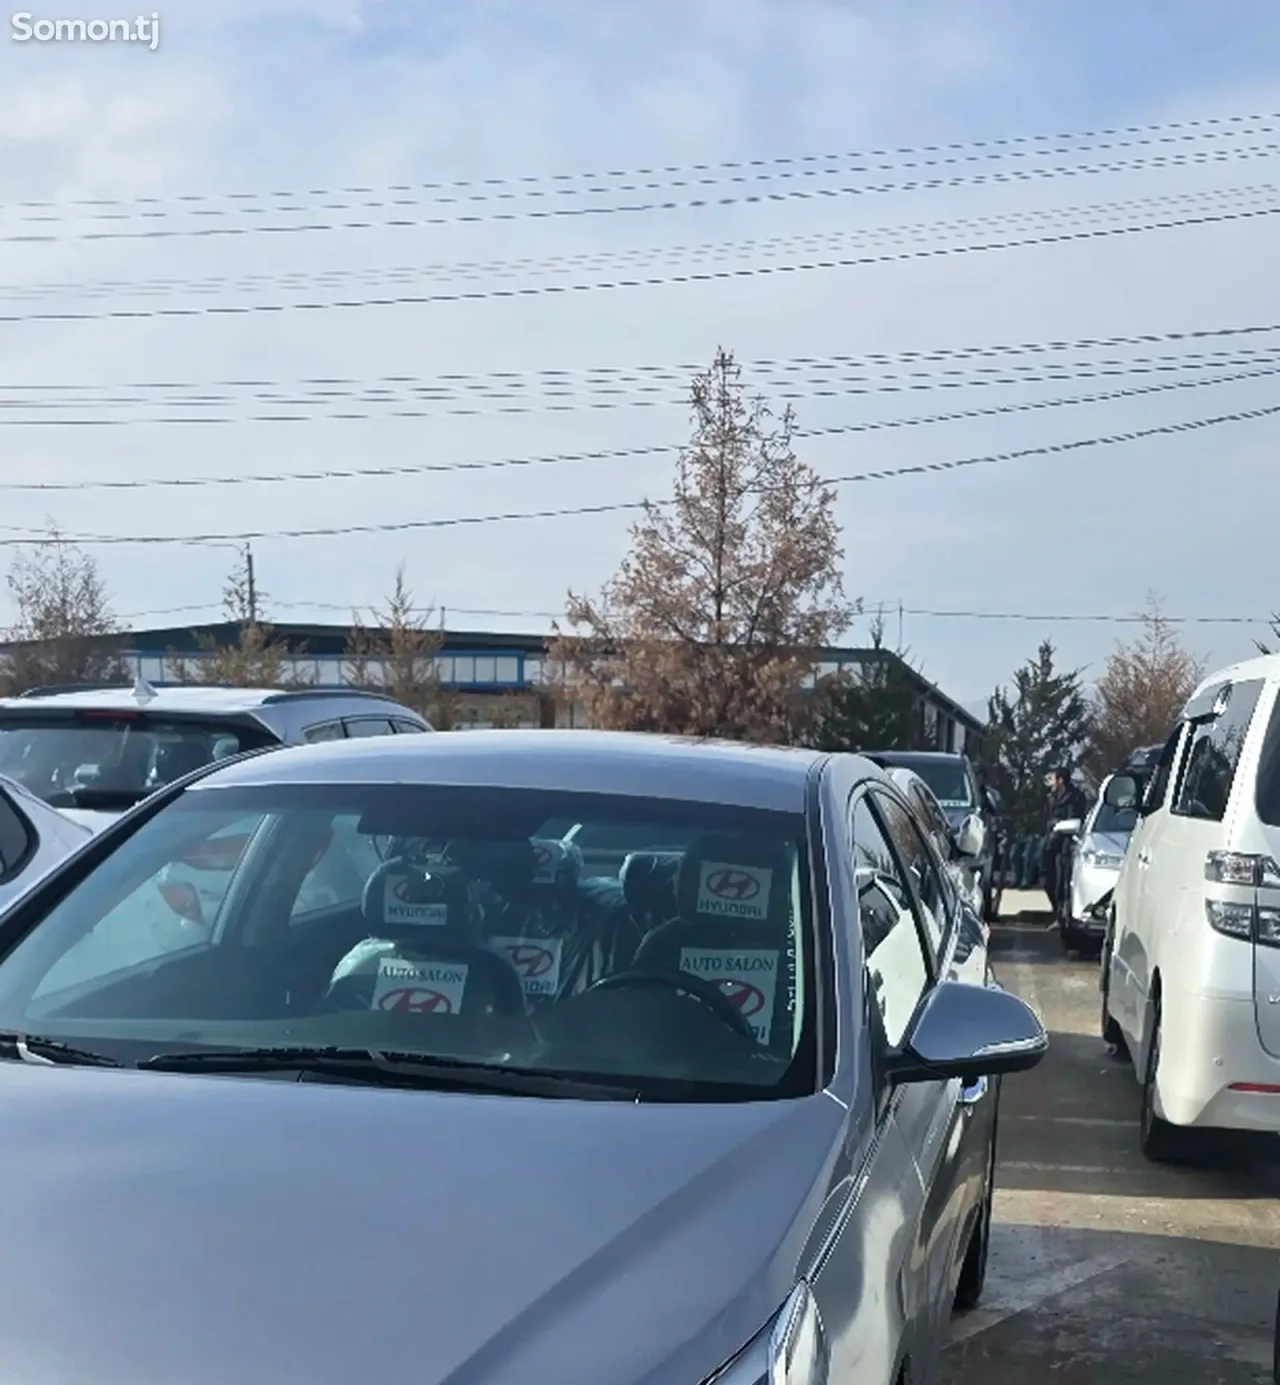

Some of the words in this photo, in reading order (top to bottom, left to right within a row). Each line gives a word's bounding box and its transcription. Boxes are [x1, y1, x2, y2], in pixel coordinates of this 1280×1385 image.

[682, 957, 722, 971] AUTO
[724, 957, 774, 971] SALON
[419, 969, 464, 983] SALON
